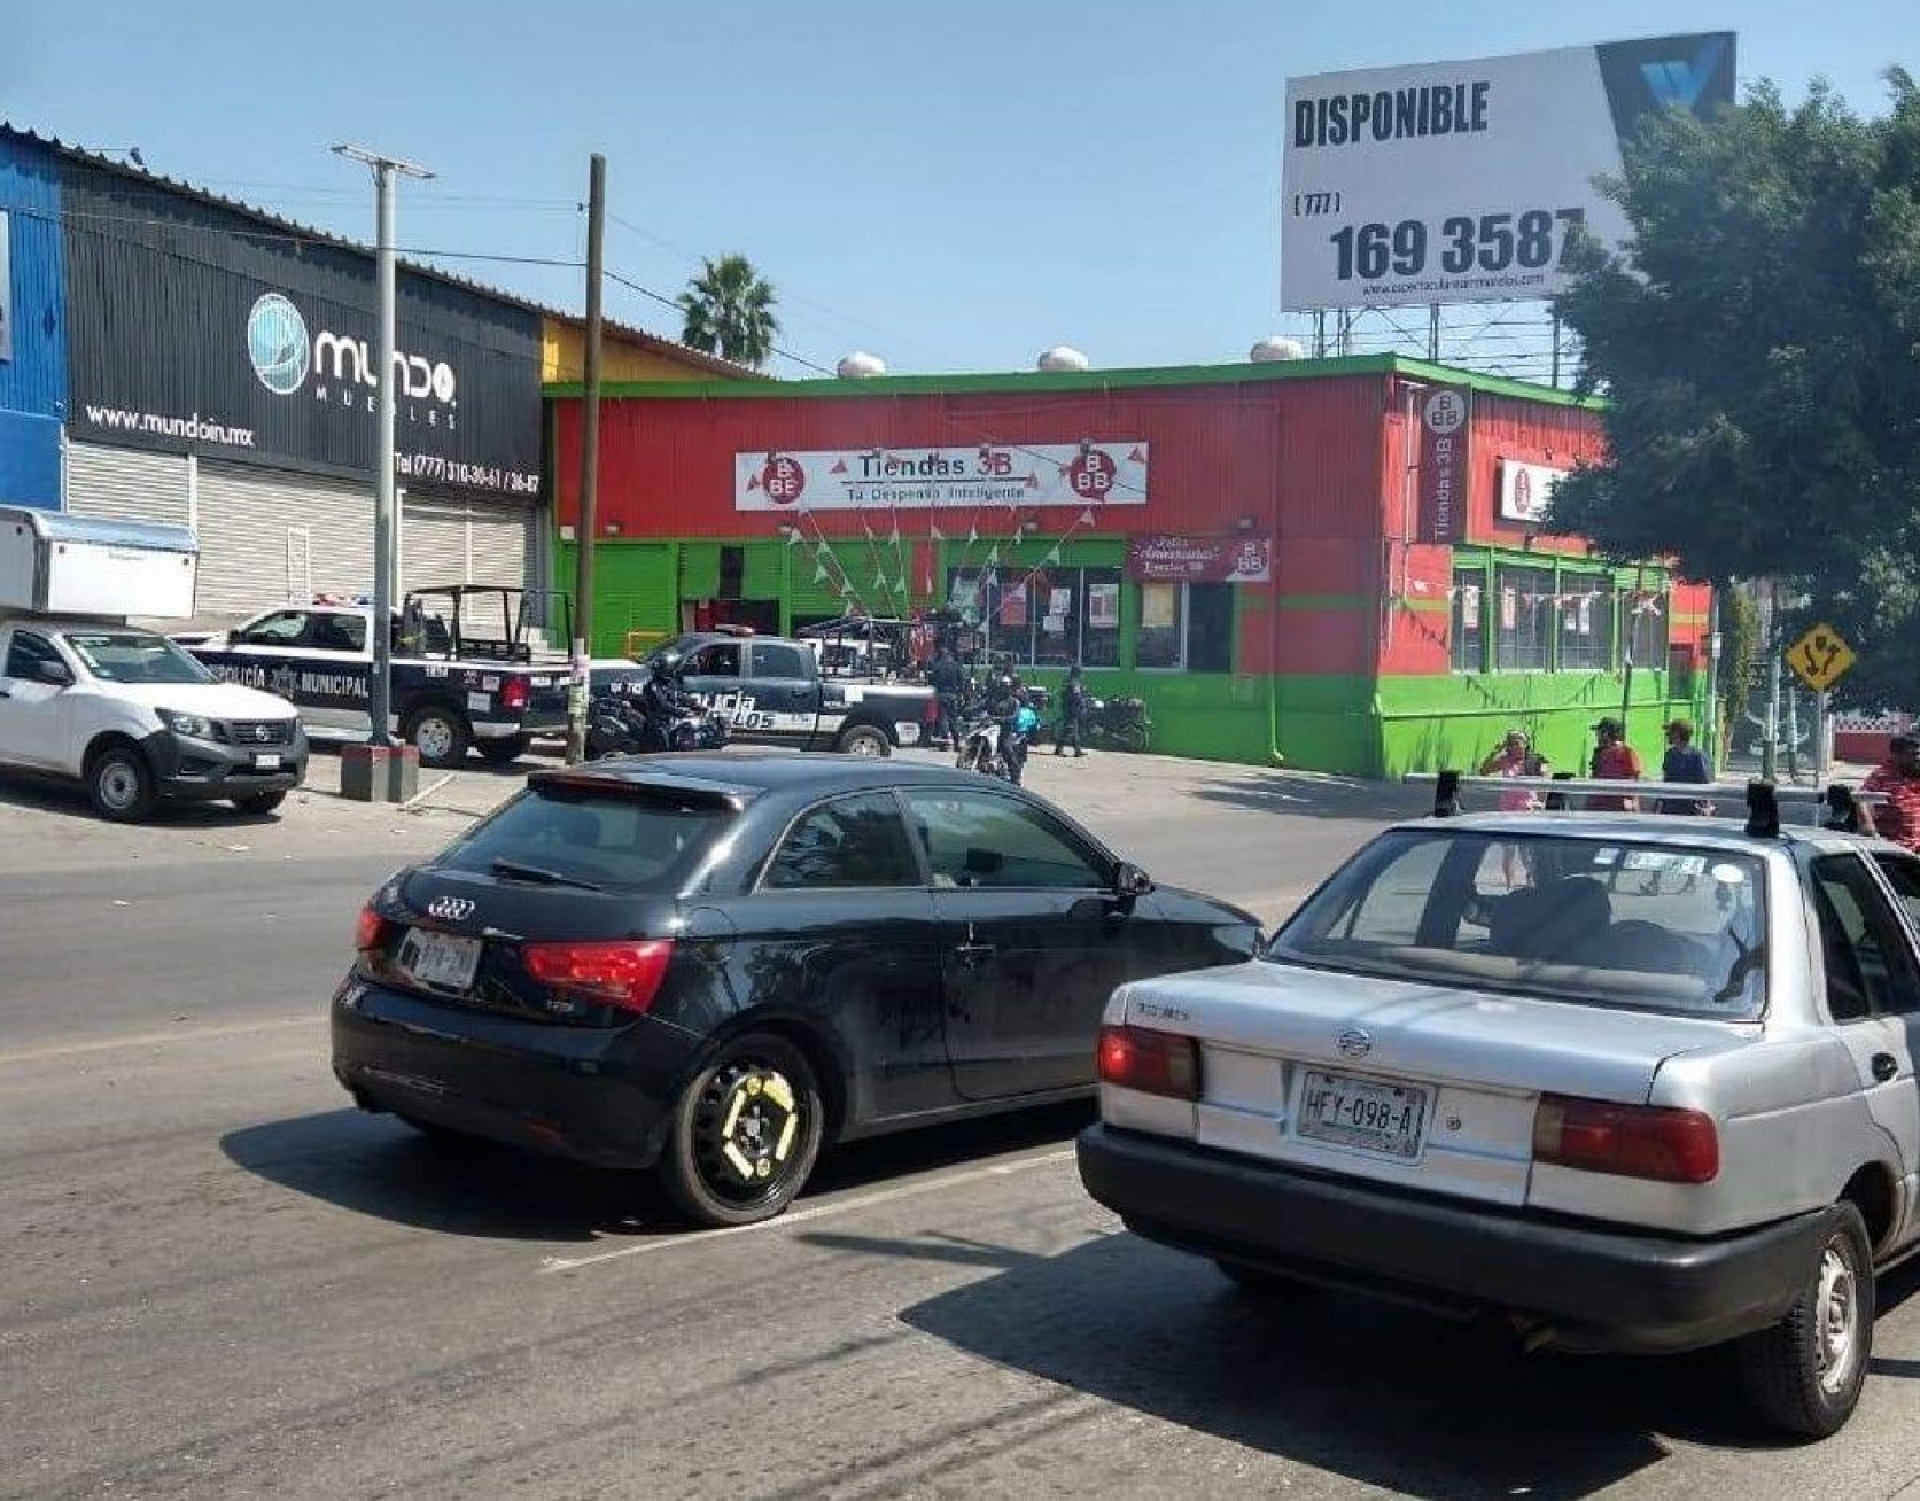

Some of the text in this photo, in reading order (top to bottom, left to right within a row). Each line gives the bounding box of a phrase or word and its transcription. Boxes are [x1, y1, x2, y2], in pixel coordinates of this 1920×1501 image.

[1295, 80, 1490, 147] DISPONIBLE
[1330, 207, 1585, 280] 169 3587
[316, 386, 455, 430] MUELES
[858, 452, 1012, 477] Tiendas 3B
[301, 672, 369, 699] MUNICIPAL
